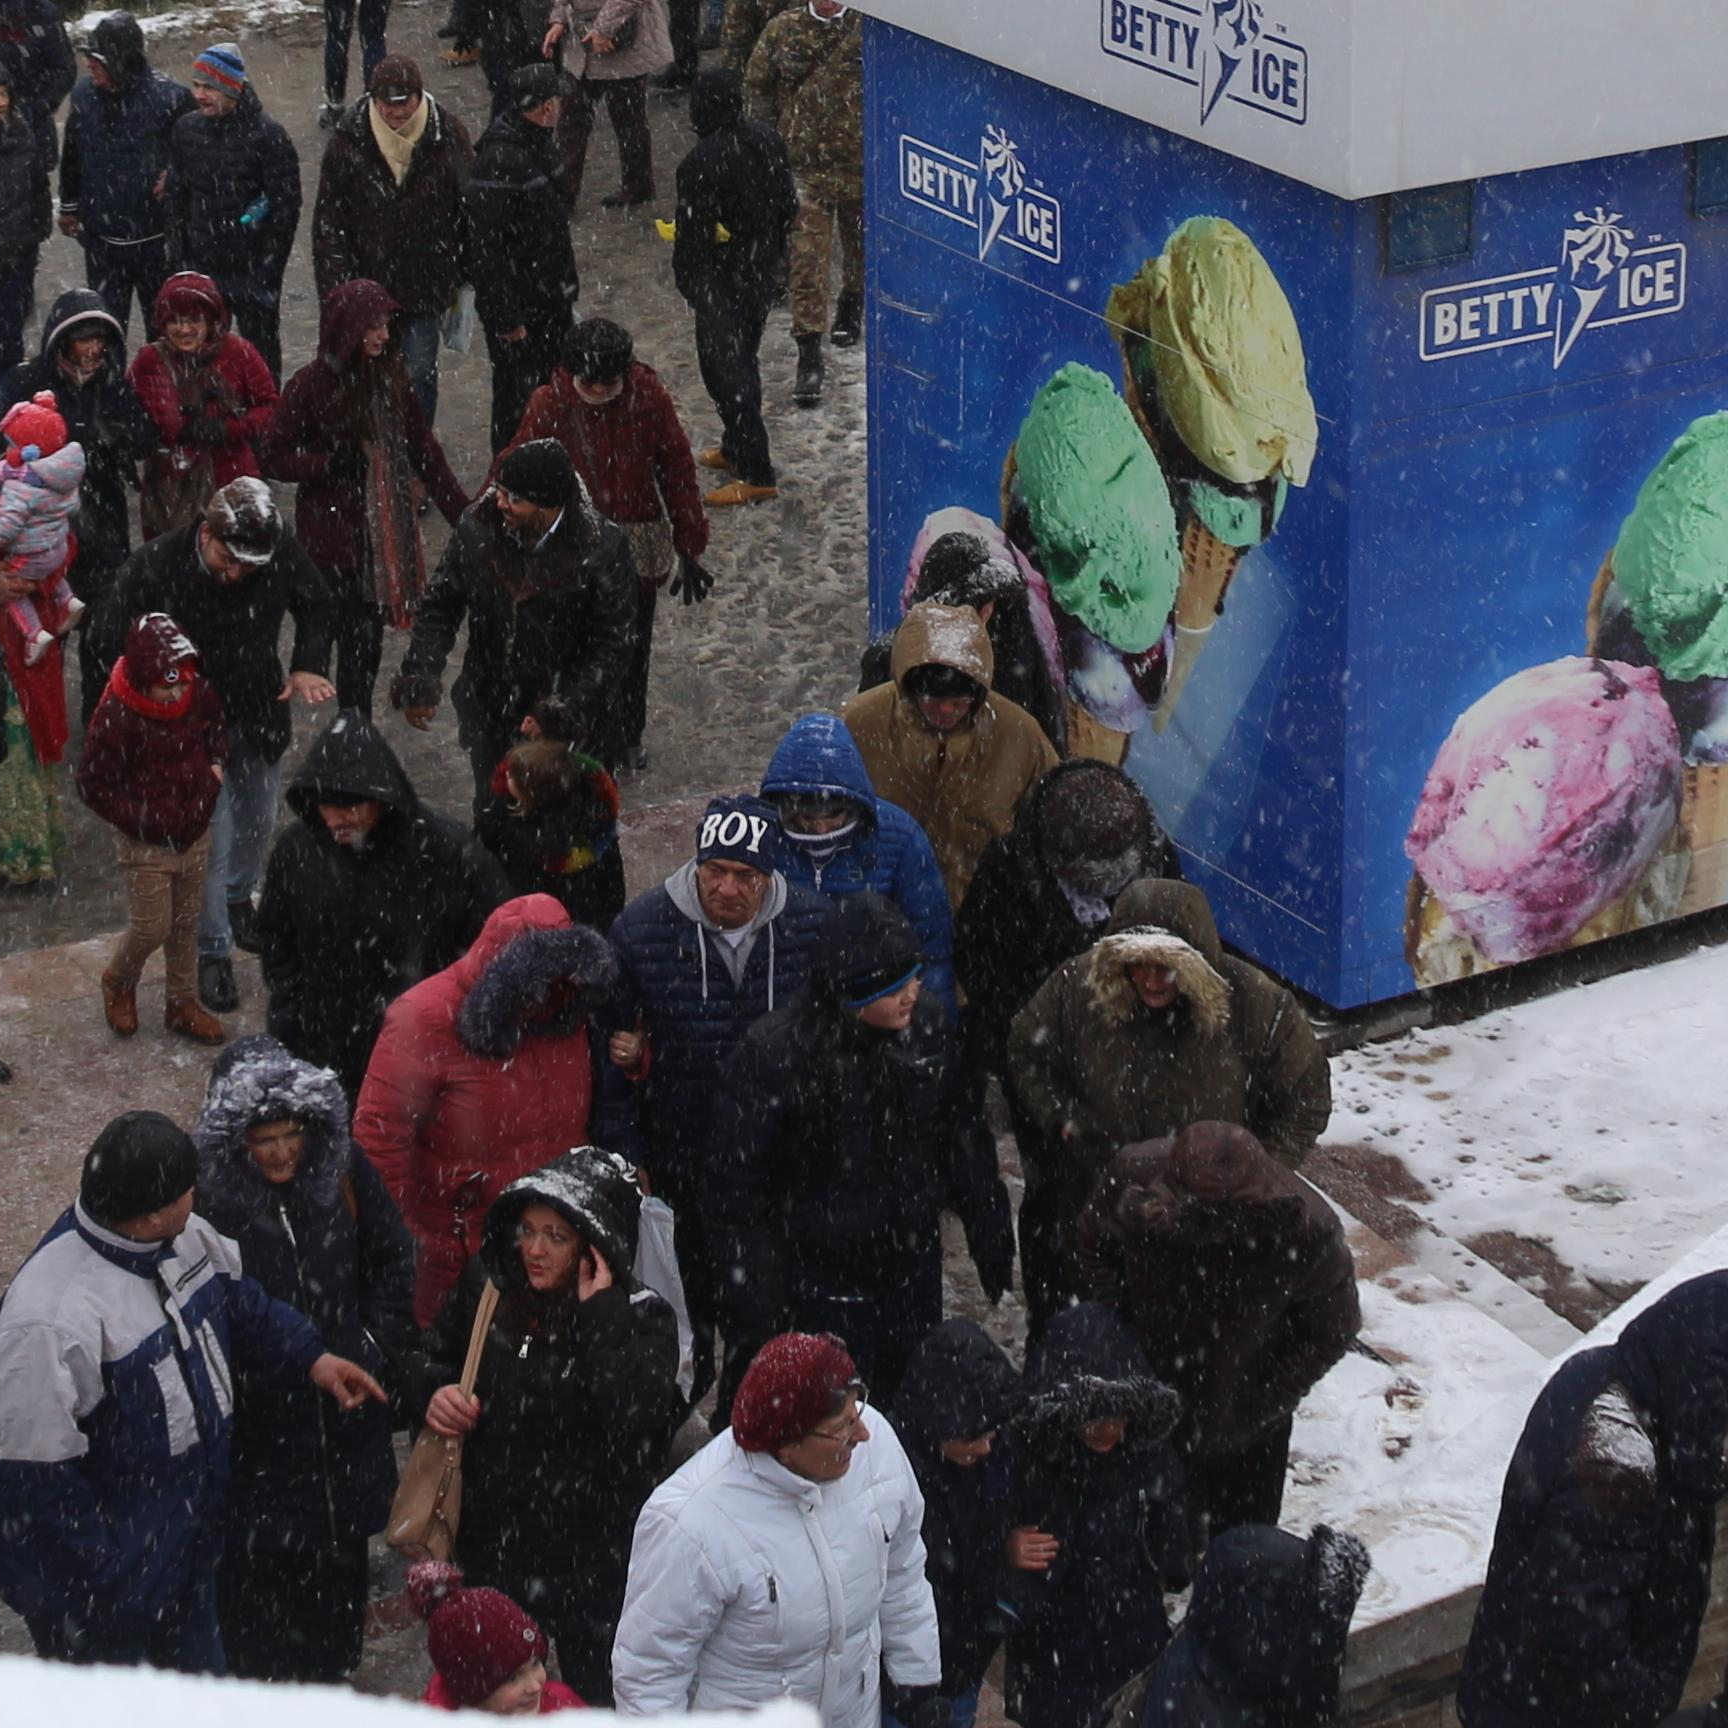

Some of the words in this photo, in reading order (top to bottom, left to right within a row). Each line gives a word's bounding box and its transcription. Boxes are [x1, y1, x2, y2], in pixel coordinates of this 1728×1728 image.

[1252, 48, 1299, 108] ICE
[907, 150, 978, 215] BETTY
[1016, 197, 1055, 251] ICE
[1433, 282, 1555, 347] BETTY
[1618, 259, 1676, 310] ICE
[699, 810, 769, 854] BOY
